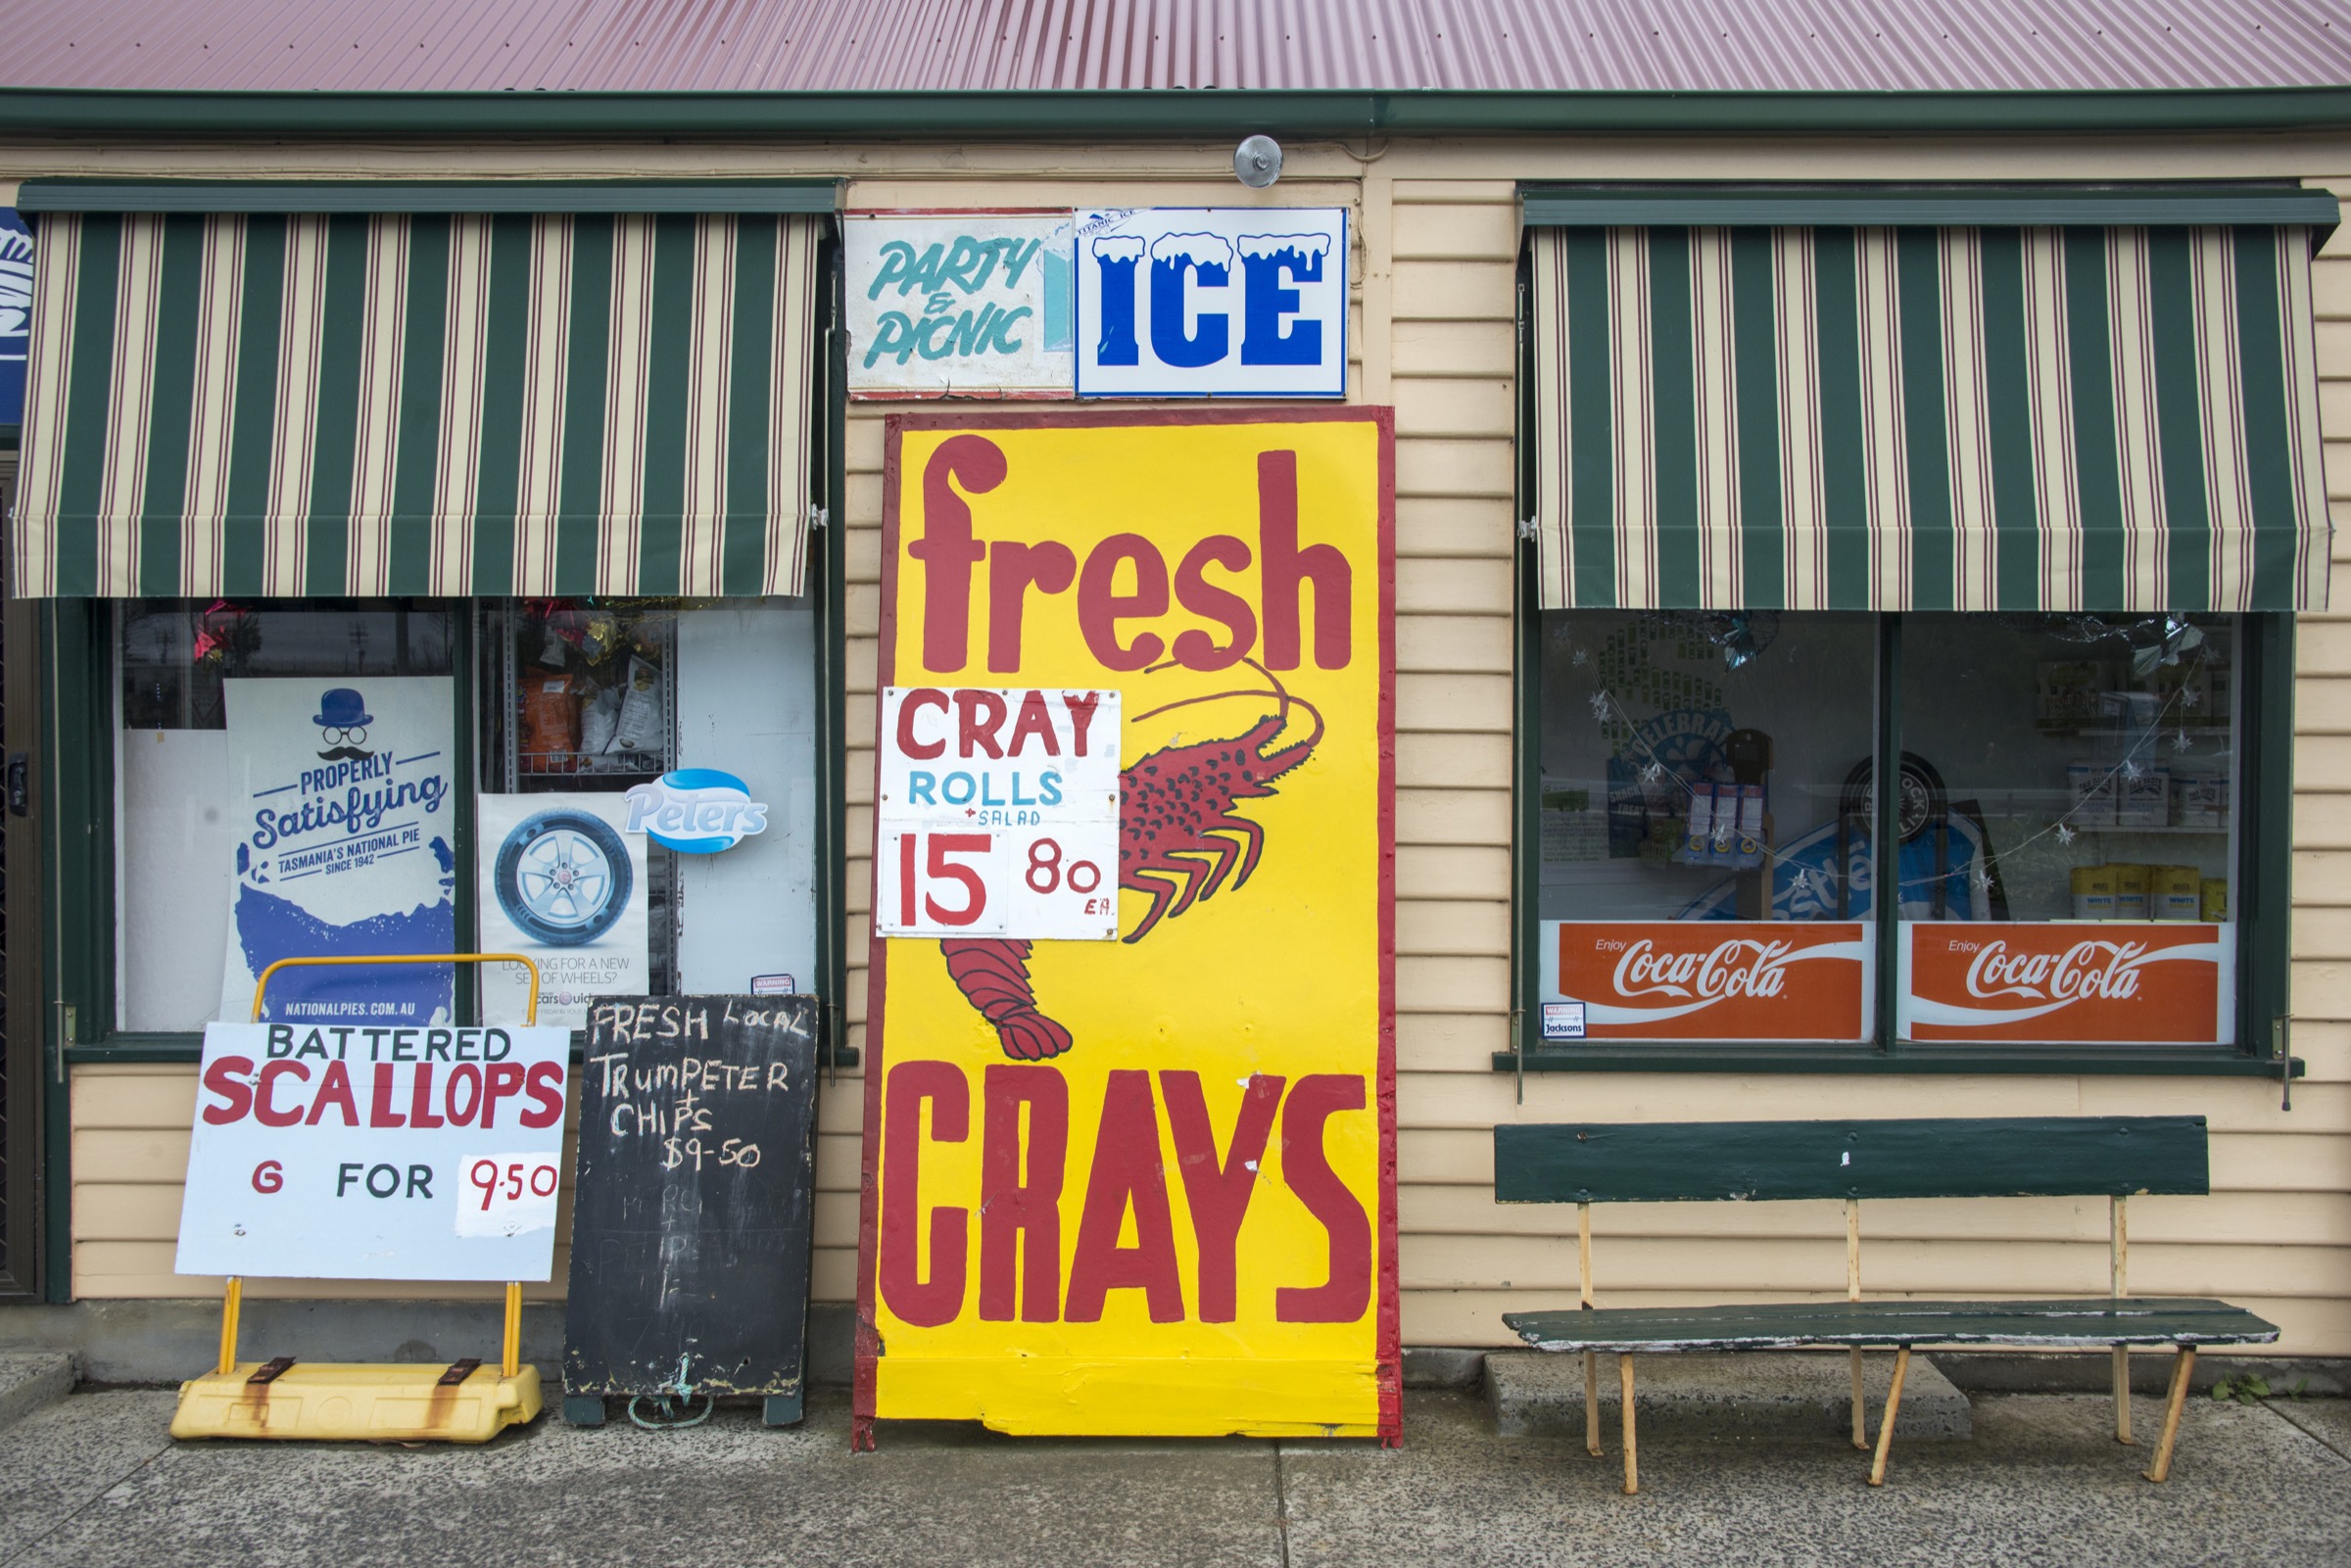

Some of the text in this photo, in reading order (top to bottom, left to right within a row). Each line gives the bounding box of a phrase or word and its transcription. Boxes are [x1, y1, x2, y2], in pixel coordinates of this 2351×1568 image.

[1077, 209, 1136, 235] TITANIC ICE
[868, 235, 1041, 301] PARTY
[924, 292, 957, 314] &
[1091, 232, 1331, 368] ICE
[863, 302, 1033, 369] PICNIC
[907, 434, 1353, 674] fresh
[896, 688, 1099, 760] CRAY
[301, 751, 393, 795] PROPERLY
[909, 771, 1063, 806] ROLLS
[253, 775, 449, 849] Satisfying
[626, 784, 766, 833] Peters
[1608, 784, 1641, 803] SNACK
[1617, 803, 1646, 817] TREAT
[1901, 778, 1925, 810] OCK
[978, 810, 1041, 827] SALAD
[278, 829, 420, 874] TASMANIA'S NATIONAL PIE
[325, 854, 374, 875] SINCE 1942
[900, 833, 992, 927] 15
[1026, 837, 1101, 894] 80
[502, 957, 630, 971] LOOING FOR A NEW
[515, 972, 618, 984] SE OF WHEELS?
[755, 978, 791, 987] WARNING
[1596, 938, 1793, 998] Enjoy Coca-Cola
[1948, 939, 2148, 1000] Enjoy Coca-Cola
[592, 1003, 709, 1044] FRESH
[1546, 1023, 1582, 1034] Jacksons
[1547, 1006, 1582, 1015] WARNING
[266, 1023, 511, 1062] BATTERED
[202, 1056, 564, 1129] SCALLOPS
[609, 1099, 713, 1137] CHIPS
[336, 1163, 434, 1199] FOR
[879, 1060, 1372, 1328] CRAYS
